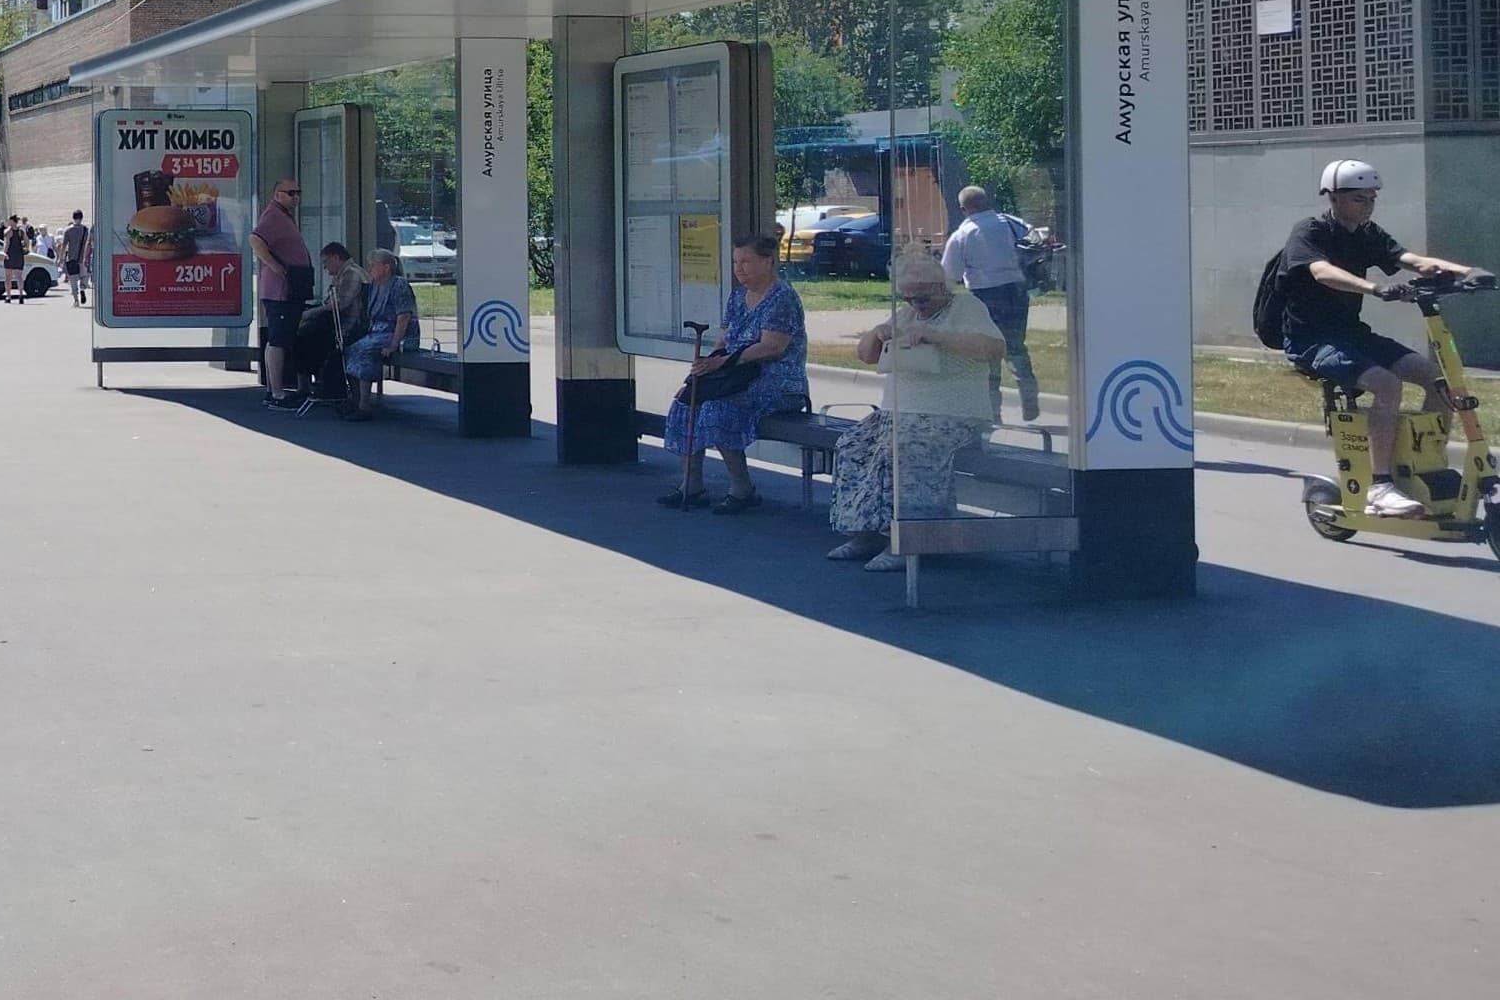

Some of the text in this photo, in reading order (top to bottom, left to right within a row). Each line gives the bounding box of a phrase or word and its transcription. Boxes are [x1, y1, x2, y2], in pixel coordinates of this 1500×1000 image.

[1115, 31, 1135, 145] Амурская
[1138, 1, 1151, 82] Amurskaya
[118, 129, 235, 150] ХИТ КОМБО
[482, 68, 495, 177] Амурская улица
